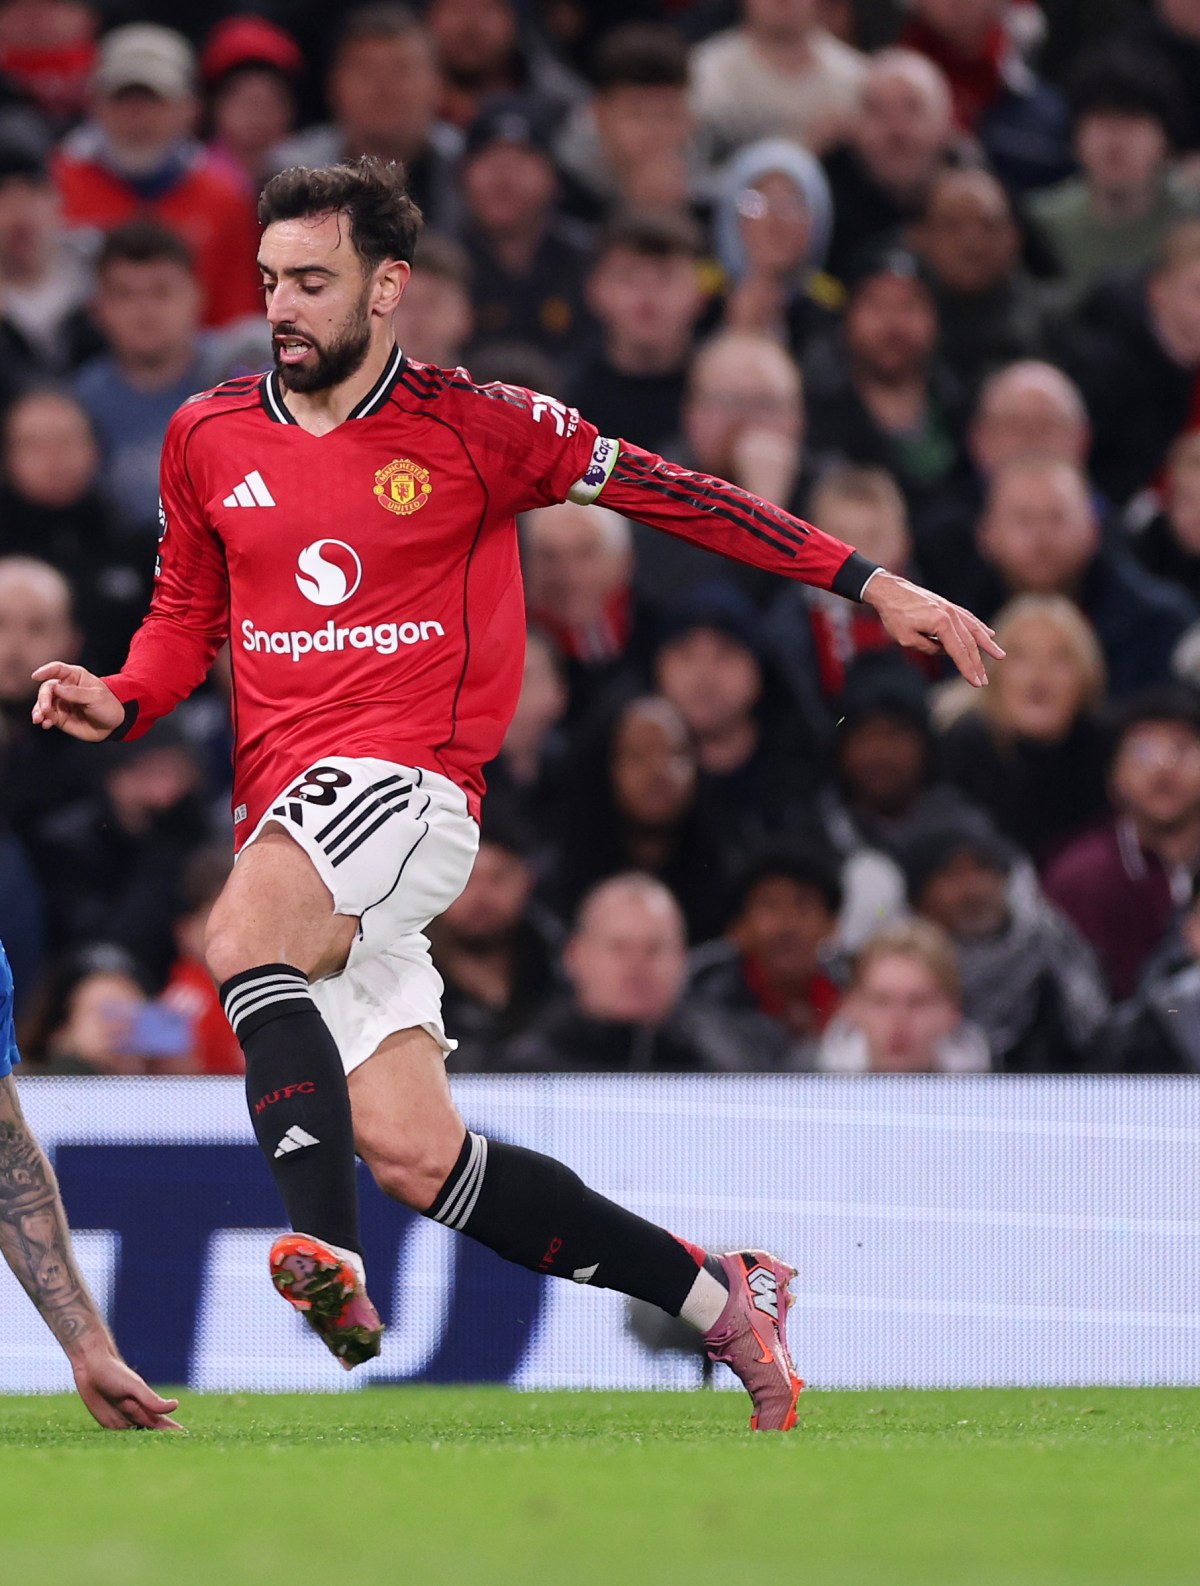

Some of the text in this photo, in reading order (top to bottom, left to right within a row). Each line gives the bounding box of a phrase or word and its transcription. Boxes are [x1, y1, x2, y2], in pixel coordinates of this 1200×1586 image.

[592, 437, 615, 464] Cap
[379, 463, 426, 481] MANCHESTER
[387, 501, 420, 511] UNITED
[241, 620, 445, 662] Snapdragon
[286, 766, 352, 806] 8
[254, 1080, 316, 1115] MUFC
